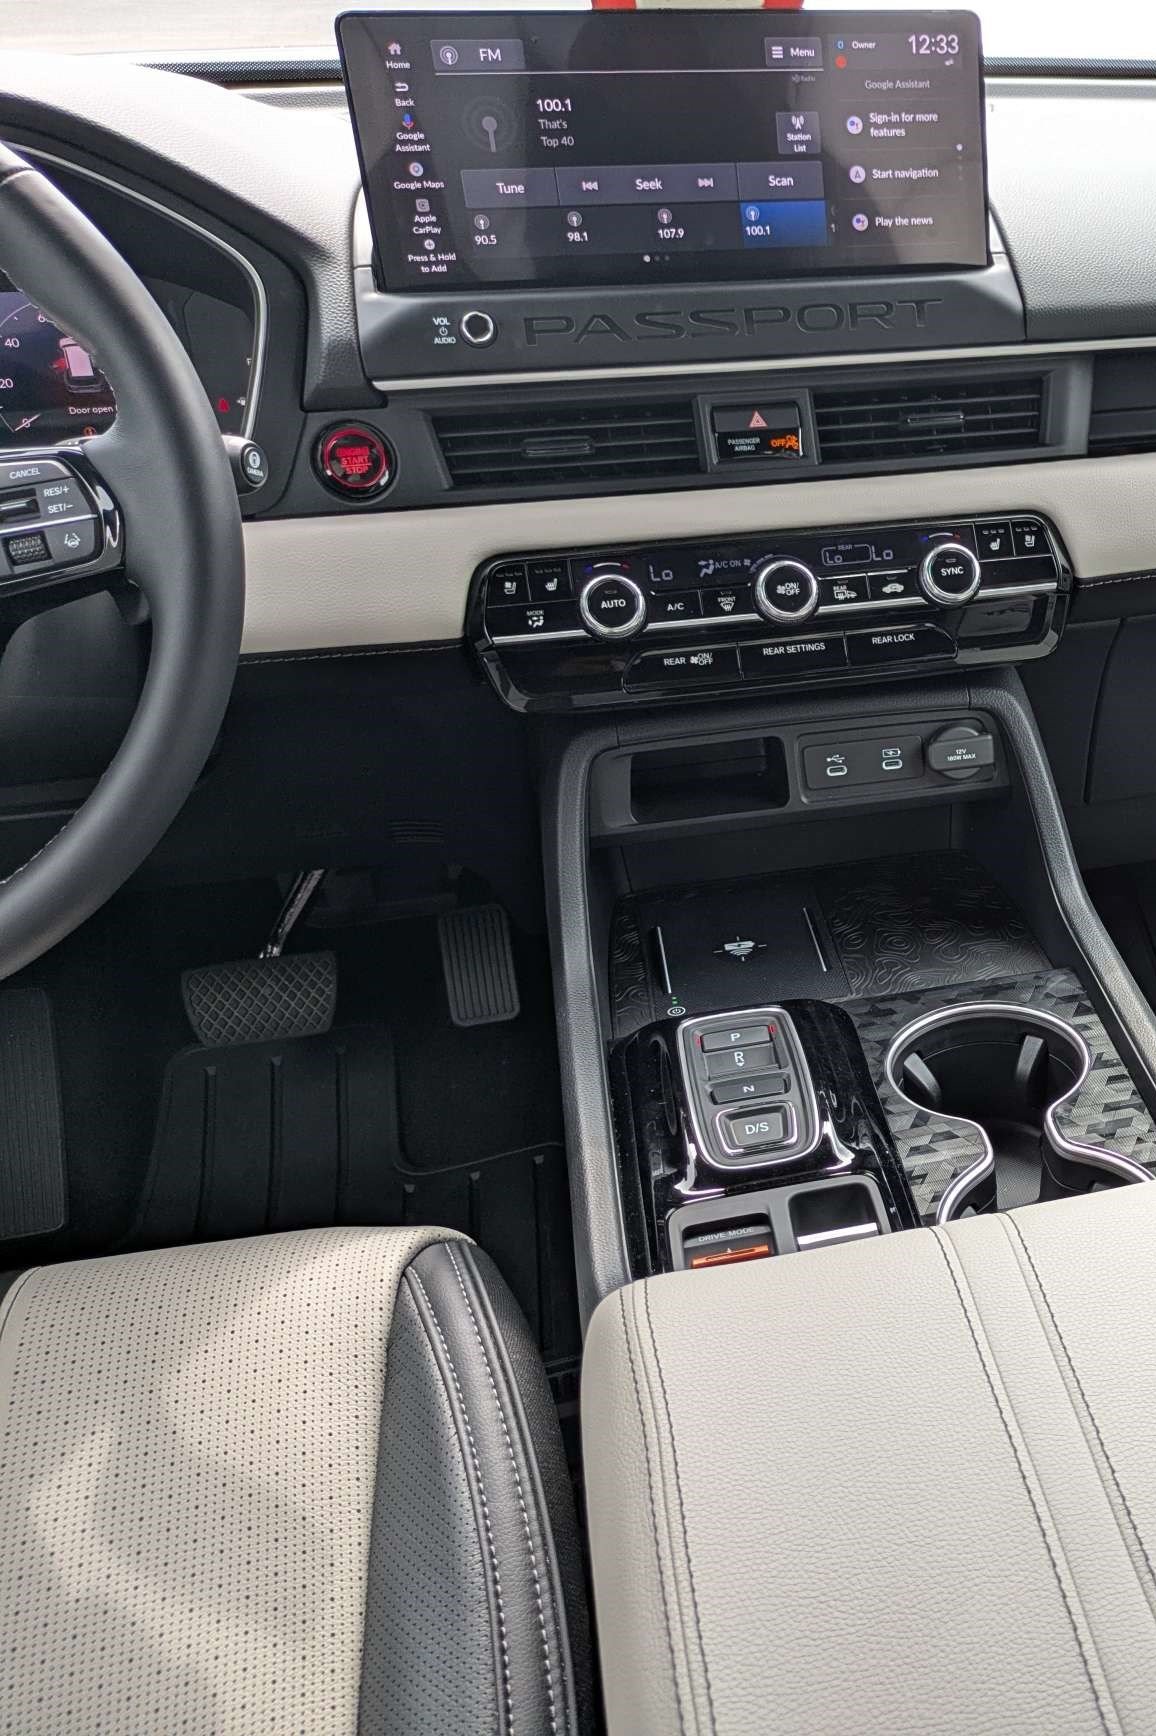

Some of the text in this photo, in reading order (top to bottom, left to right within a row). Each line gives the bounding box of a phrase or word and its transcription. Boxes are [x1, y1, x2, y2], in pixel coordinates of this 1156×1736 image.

[851, 41, 876, 50] Owner
[908, 34, 959, 55] 12:33
[479, 48, 502, 62] FM
[790, 47, 815, 58] Menu
[386, 60, 411, 69] Home
[865, 79, 930, 90] Google Assistant
[395, 98, 415, 107] Back
[536, 98, 573, 112] 100.1
[869, 113, 938, 124] Sign-in for more
[538, 119, 568, 130] That's
[396, 132, 425, 141] Google
[870, 127, 906, 137] features
[540, 136, 575, 148] Top 40
[786, 133, 812, 142] Station
[395, 144, 431, 152] Assistant
[794, 144, 807, 153] List
[872, 168, 939, 180] Start navigation
[393, 180, 445, 190] Google Maps
[635, 178, 663, 191] Seek
[768, 175, 794, 188] Scan
[496, 182, 525, 195] Tune
[414, 215, 437, 224] Apple
[875, 216, 934, 227] Play the news
[412, 226, 442, 235] CarPlay
[657, 228, 685, 239] 107.9
[745, 225, 771, 236] 100.1
[474, 235, 497, 246] 90.5
[567, 232, 588, 242] 98.1
[408, 253, 457, 262] Press & Hold
[421, 264, 447, 273] to Add
[433, 317, 450, 326] VOL
[523, 298, 943, 347] PASSPORT
[4, 337, 20, 348] 40
[434, 336, 456, 344] AUDIO
[68, 406, 114, 415] Door open
[727, 437, 760, 445] PASSENGER
[770, 439, 786, 448] OFF
[341, 456, 370, 465] START
[9, 468, 41, 479] CANCEL
[346, 466, 369, 475] STOP
[715, 560, 741, 569] A/C ON
[940, 565, 964, 577] SYNC
[785, 582, 799, 590] ON/
[786, 588, 800, 596] OFF
[600, 598, 626, 609] AUTO
[667, 602, 685, 612] A/C
[872, 633, 916, 645] REAR LOCK
[763, 642, 826, 656] REAR SETTINGS
[697, 652, 713, 660] ON/
[664, 657, 686, 666] REAR
[698, 658, 714, 666] OFF
[730, 1033, 741, 1042] P
[734, 1051, 744, 1063] R
[743, 1085, 755, 1093] N
[744, 1122, 769, 1135] D/S
[698, 1227, 754, 1242] DRIVE MODE
